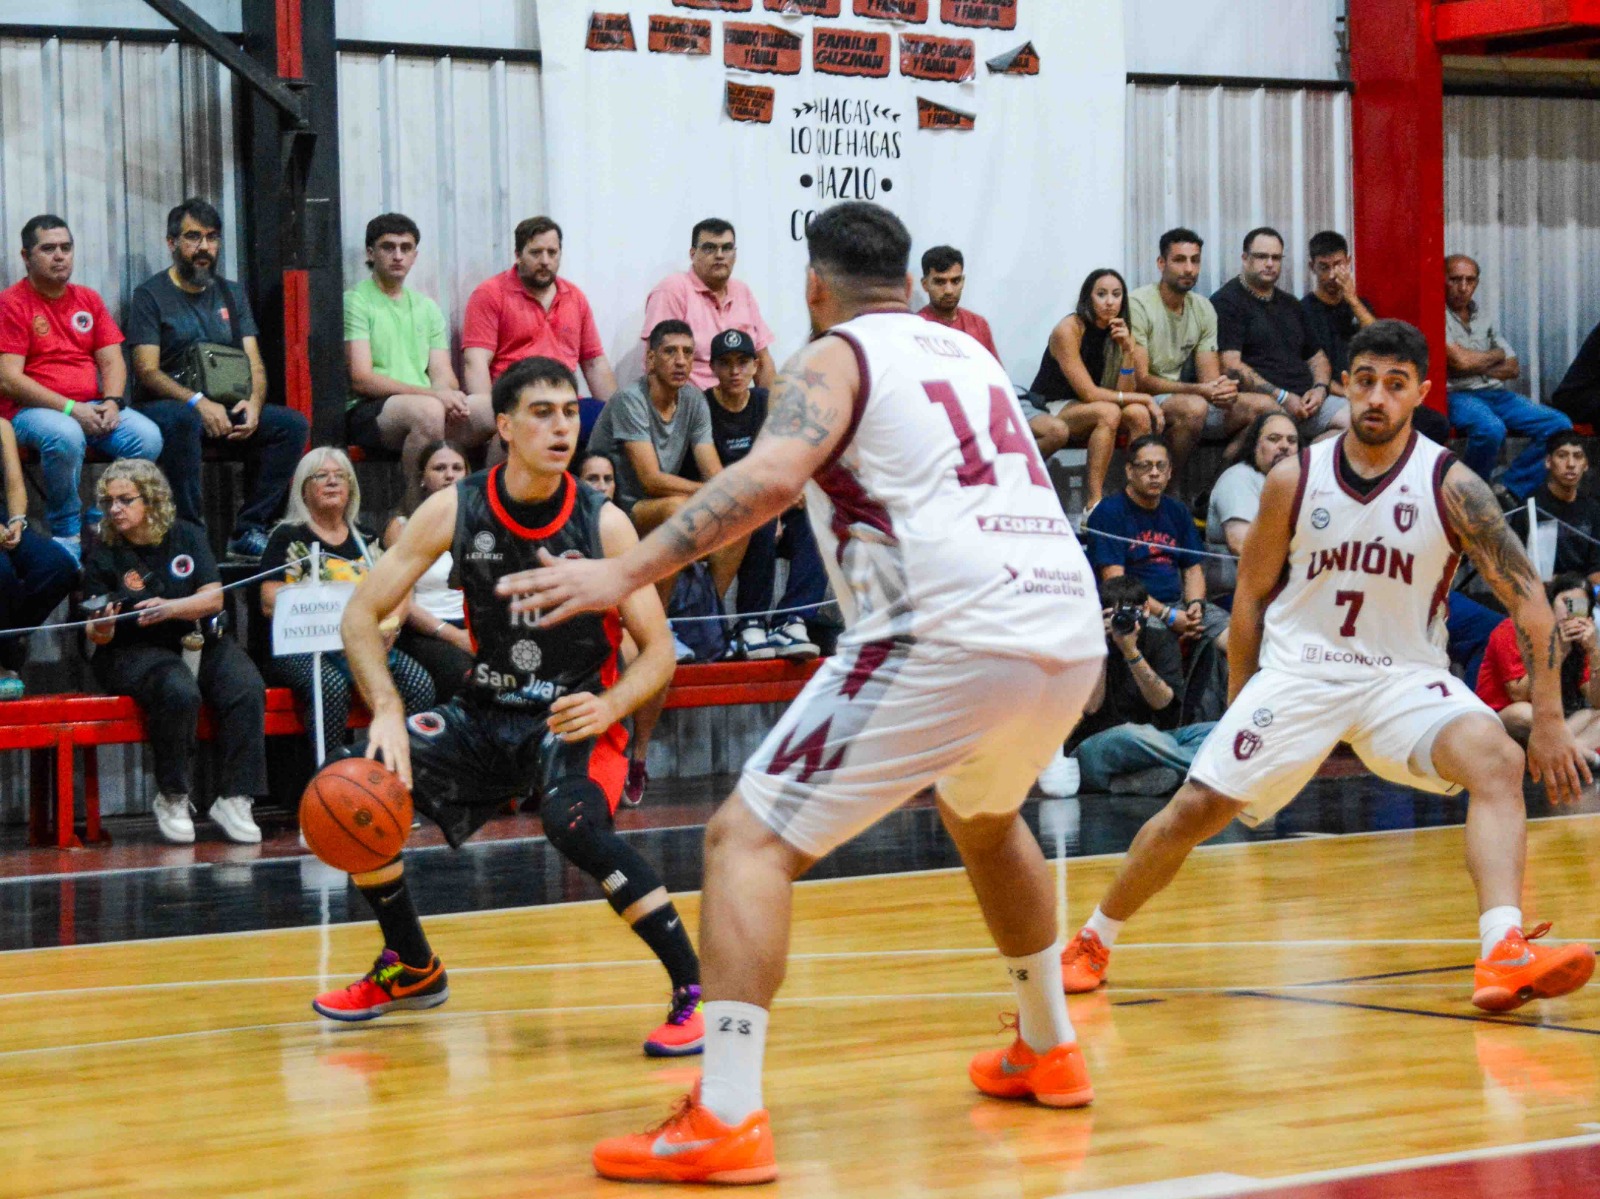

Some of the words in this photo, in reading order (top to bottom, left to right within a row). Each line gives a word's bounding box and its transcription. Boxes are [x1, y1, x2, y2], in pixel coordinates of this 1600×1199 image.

[962, 5, 1000, 21] FAMILIA
[817, 33, 878, 51] FAMILIA
[815, 50, 884, 69] GUZMAN
[912, 58, 920, 71] Y
[921, 58, 957, 74] FAMILIA
[820, 97, 871, 126] HAGAS
[790, 126, 812, 155] LO
[817, 164, 877, 201] HAZLO
[920, 379, 1053, 489] 14
[977, 515, 1070, 536] SCORZA
[1306, 535, 1415, 586] UNIÓN
[1032, 567, 1083, 584] Mutual
[1022, 580, 1086, 599] Oncativo
[289, 600, 341, 615] ABONOS
[1335, 590, 1364, 637] 7
[1324, 650, 1393, 668] ECONOVO
[476, 661, 518, 690] San
[1425, 680, 1453, 698] 7
[718, 1015, 753, 1036] 23
